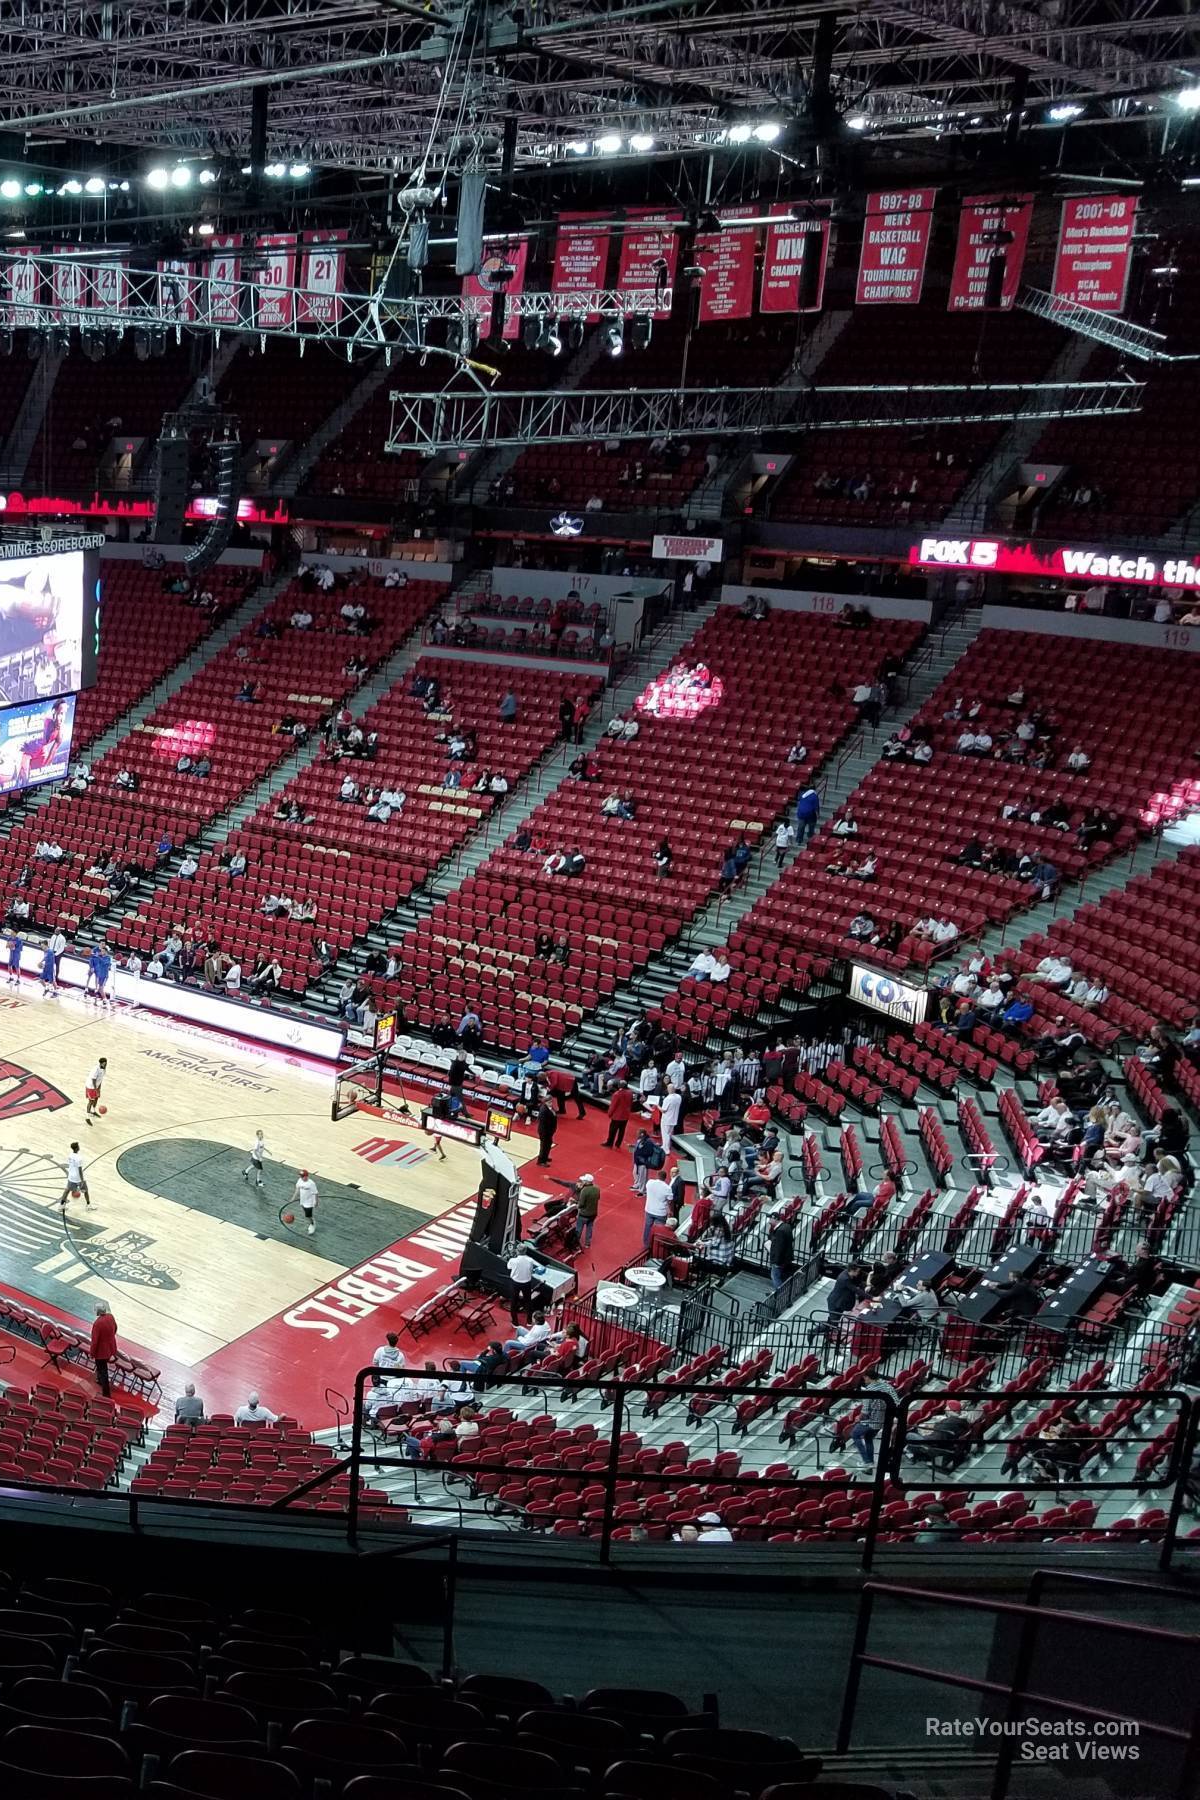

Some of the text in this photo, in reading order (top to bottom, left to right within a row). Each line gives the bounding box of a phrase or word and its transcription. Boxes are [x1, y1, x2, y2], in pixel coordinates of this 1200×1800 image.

[879, 194, 922, 210] 1997-98
[884, 213, 911, 226] MEN'S
[1075, 203, 1126, 219] 2007-08
[869, 230, 921, 244] BASKETBALL
[880, 247, 907, 265] WAC
[217, 262, 227, 279] 4
[315, 260, 331, 280] 21
[863, 269, 919, 282] TOURNAMENT
[36, 534, 106, 555] SCOREBOARD
[920, 539, 998, 566] FOX 5
[1062, 550, 1155, 581] Watch
[571, 576, 590, 590] 117
[812, 597, 834, 612] 118
[1164, 629, 1190, 646] 119
[138, 1049, 280, 1093] AMERICA FIRST
[78, 1247, 164, 1287] LAS VEGAS
[283, 1250, 438, 1340] REBELS
